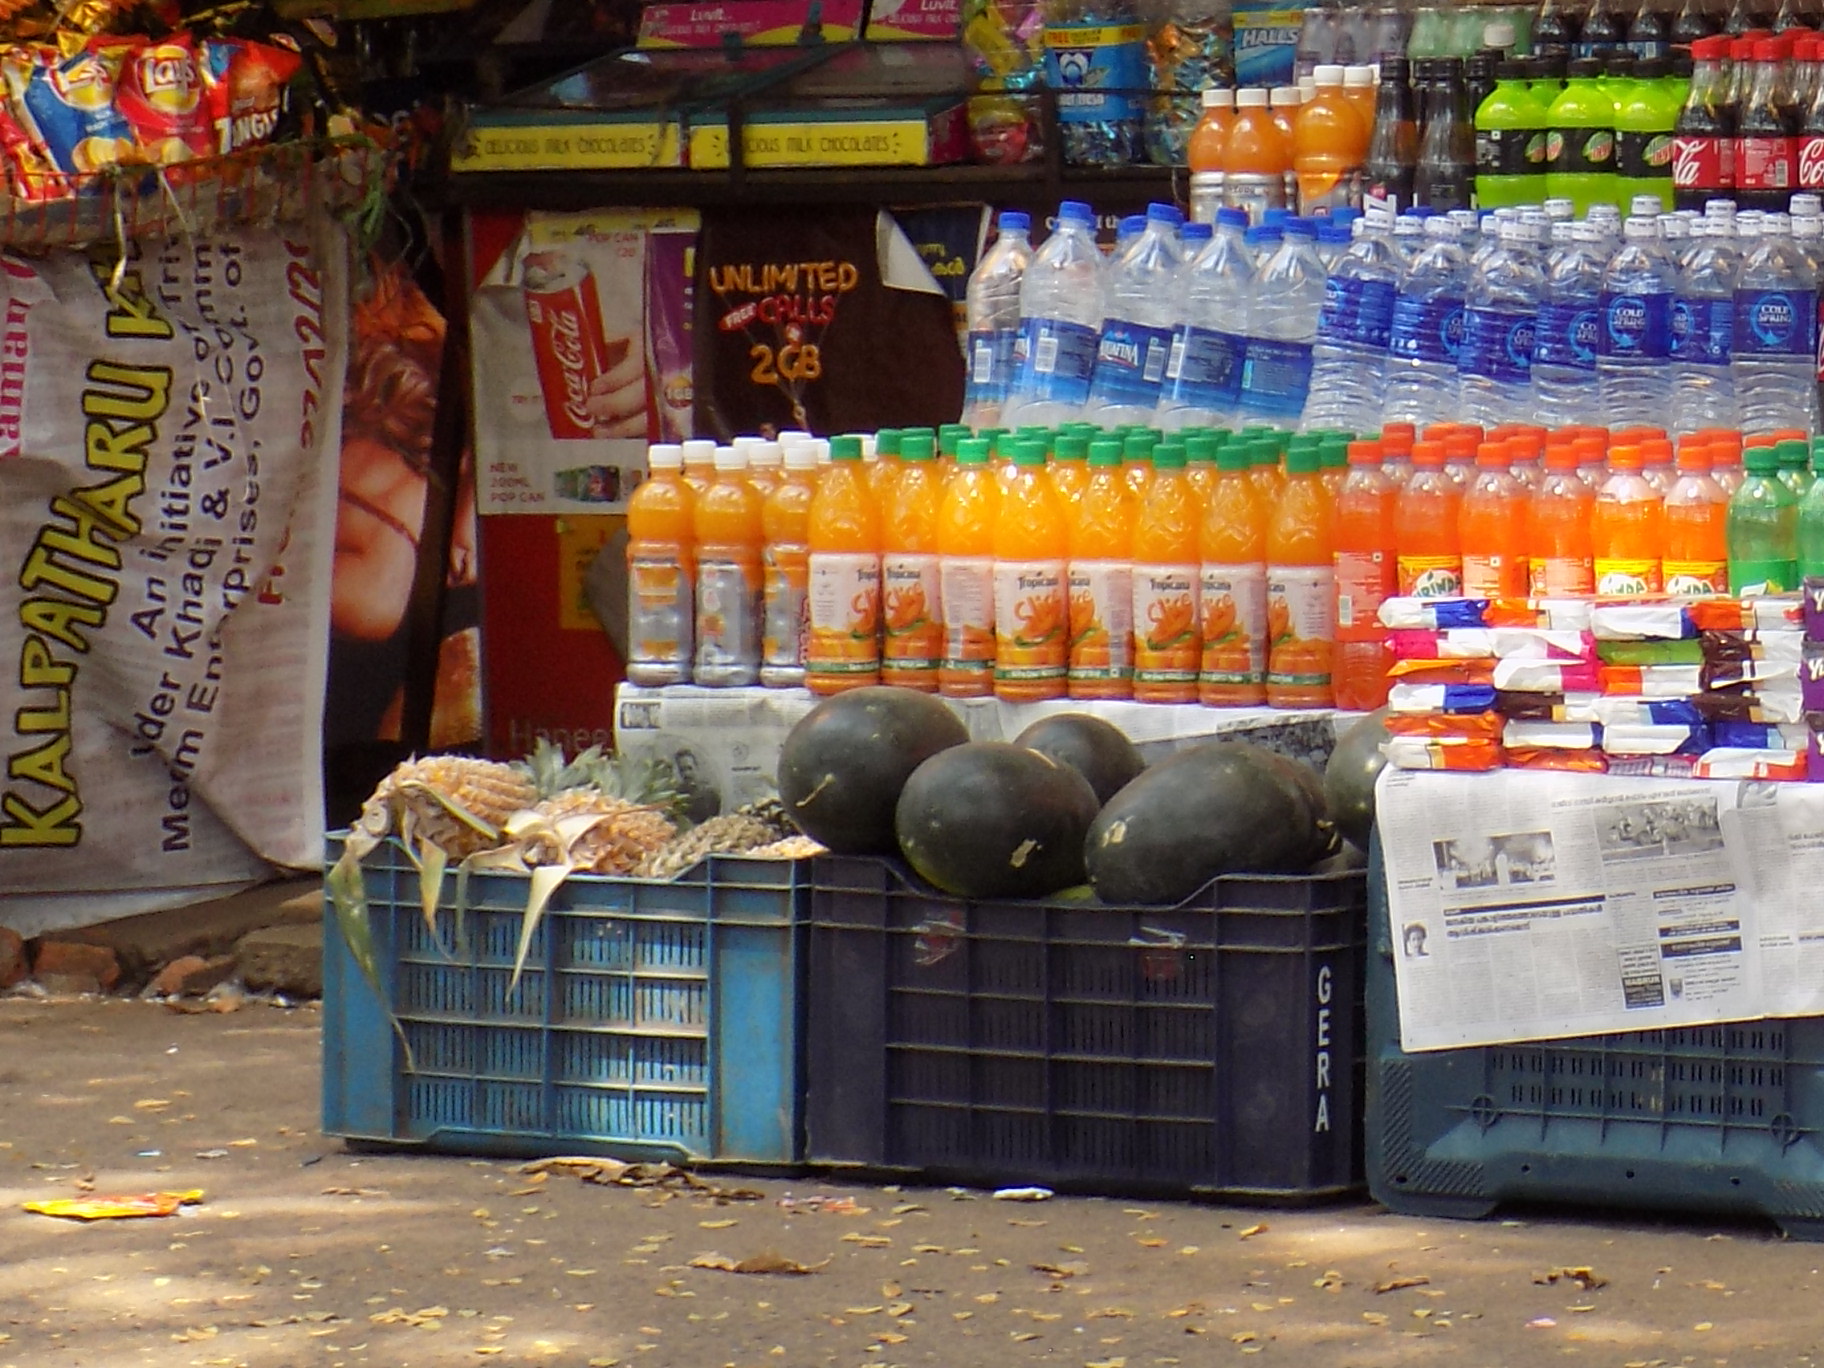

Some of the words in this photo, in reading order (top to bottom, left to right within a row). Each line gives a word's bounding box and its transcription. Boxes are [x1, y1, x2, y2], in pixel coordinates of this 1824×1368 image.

[1241, 27, 1299, 48] HALLS
[786, 134, 812, 153] MILK
[220, 242, 243, 287] of
[709, 261, 859, 295] UNLIMITED
[726, 304, 756, 327] FREE
[757, 295, 838, 325] CALLS
[1615, 307, 1645, 319] COLD
[1760, 304, 1790, 316] COLD
[750, 343, 821, 386] 2GB
[489, 463, 518, 475] NEW
[164, 537, 222, 659] Khadi
[200, 488, 229, 521] &
[1, 358, 174, 849] KALPATHARU
[129, 577, 168, 641] An
[1315, 964, 1330, 1135] GERA
